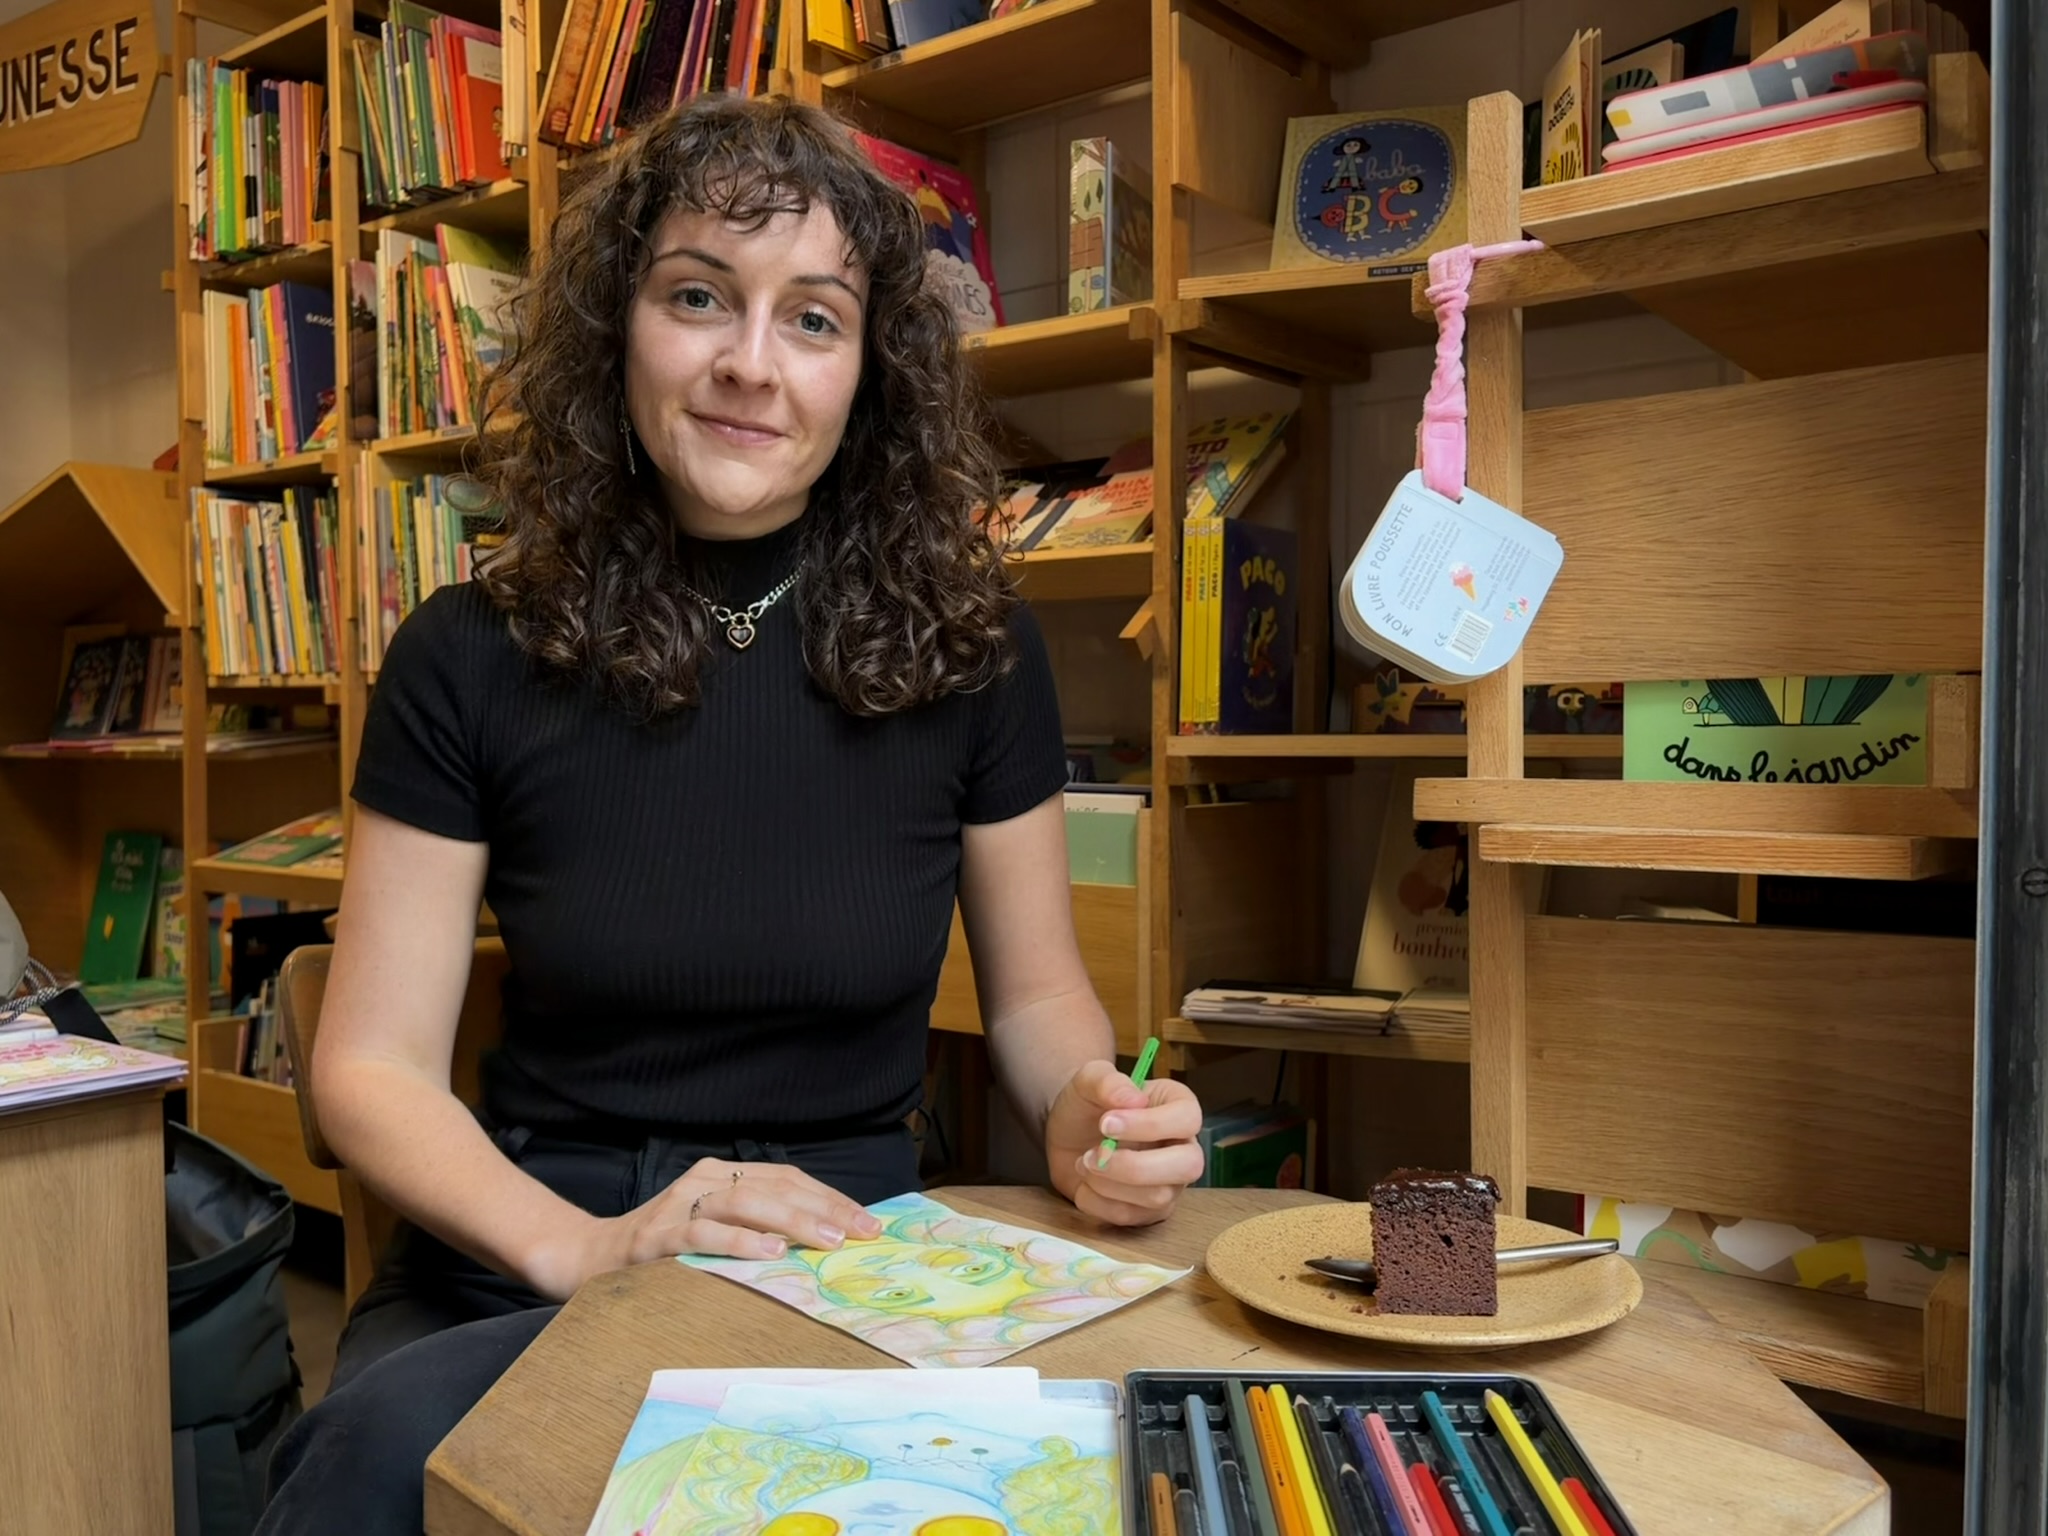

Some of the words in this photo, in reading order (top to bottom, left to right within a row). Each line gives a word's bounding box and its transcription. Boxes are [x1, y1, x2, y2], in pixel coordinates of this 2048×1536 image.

[1370, 502, 1414, 570] POUSSETTE
[1210, 572, 1218, 597] PACO
[1240, 556, 1286, 596] PACO
[1367, 574, 1387, 611] LIVRE
[1382, 612, 1414, 637] MON
[1663, 736, 1741, 782] dans
